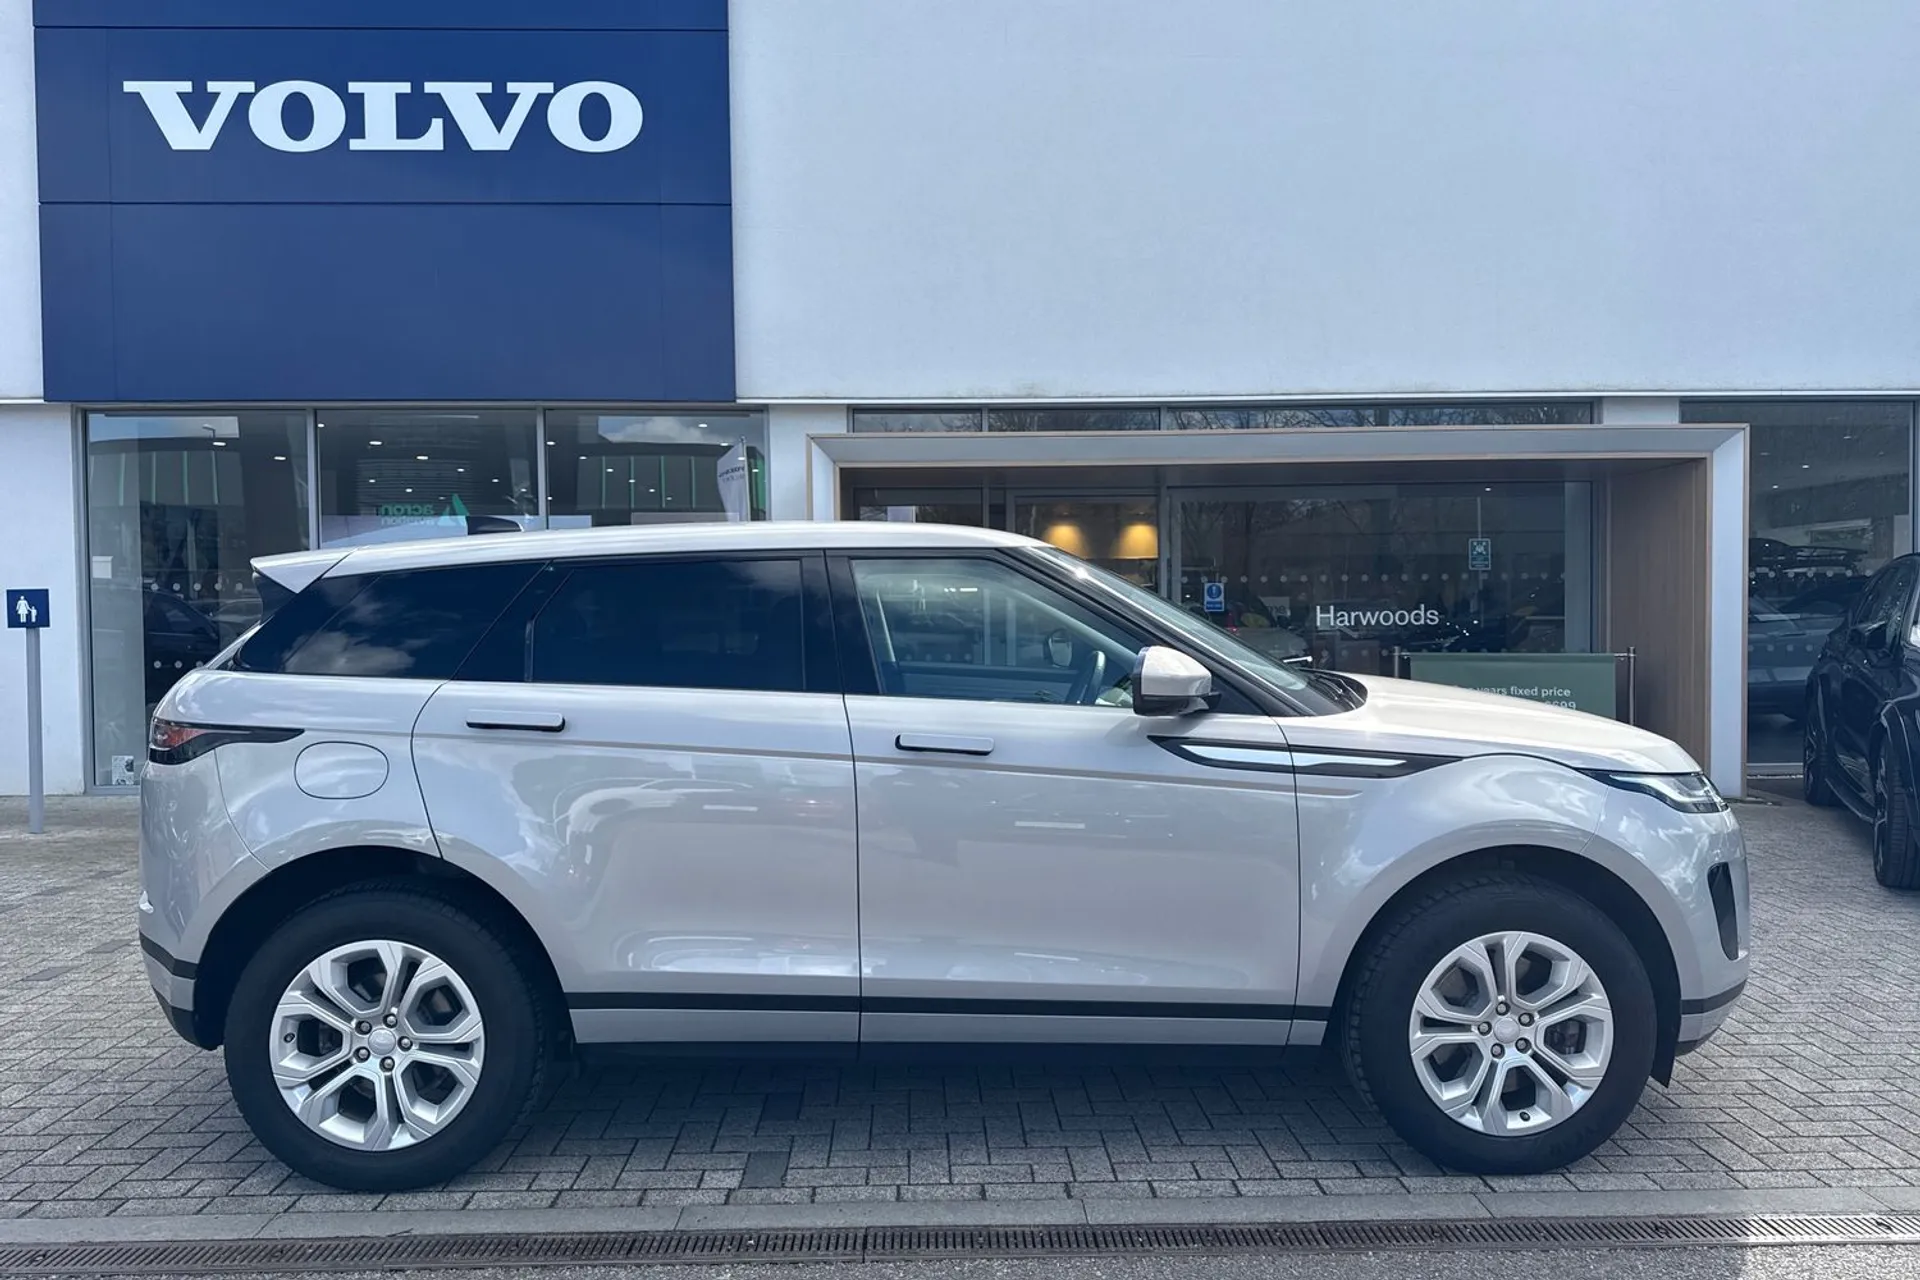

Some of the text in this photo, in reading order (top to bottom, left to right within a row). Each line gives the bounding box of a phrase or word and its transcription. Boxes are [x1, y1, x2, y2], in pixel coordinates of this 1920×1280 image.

[123, 80, 643, 152] VOLVO
[1316, 604, 1440, 626] Harwoods
[1510, 686, 1538, 697] fixed
[1541, 686, 1571, 698] price
